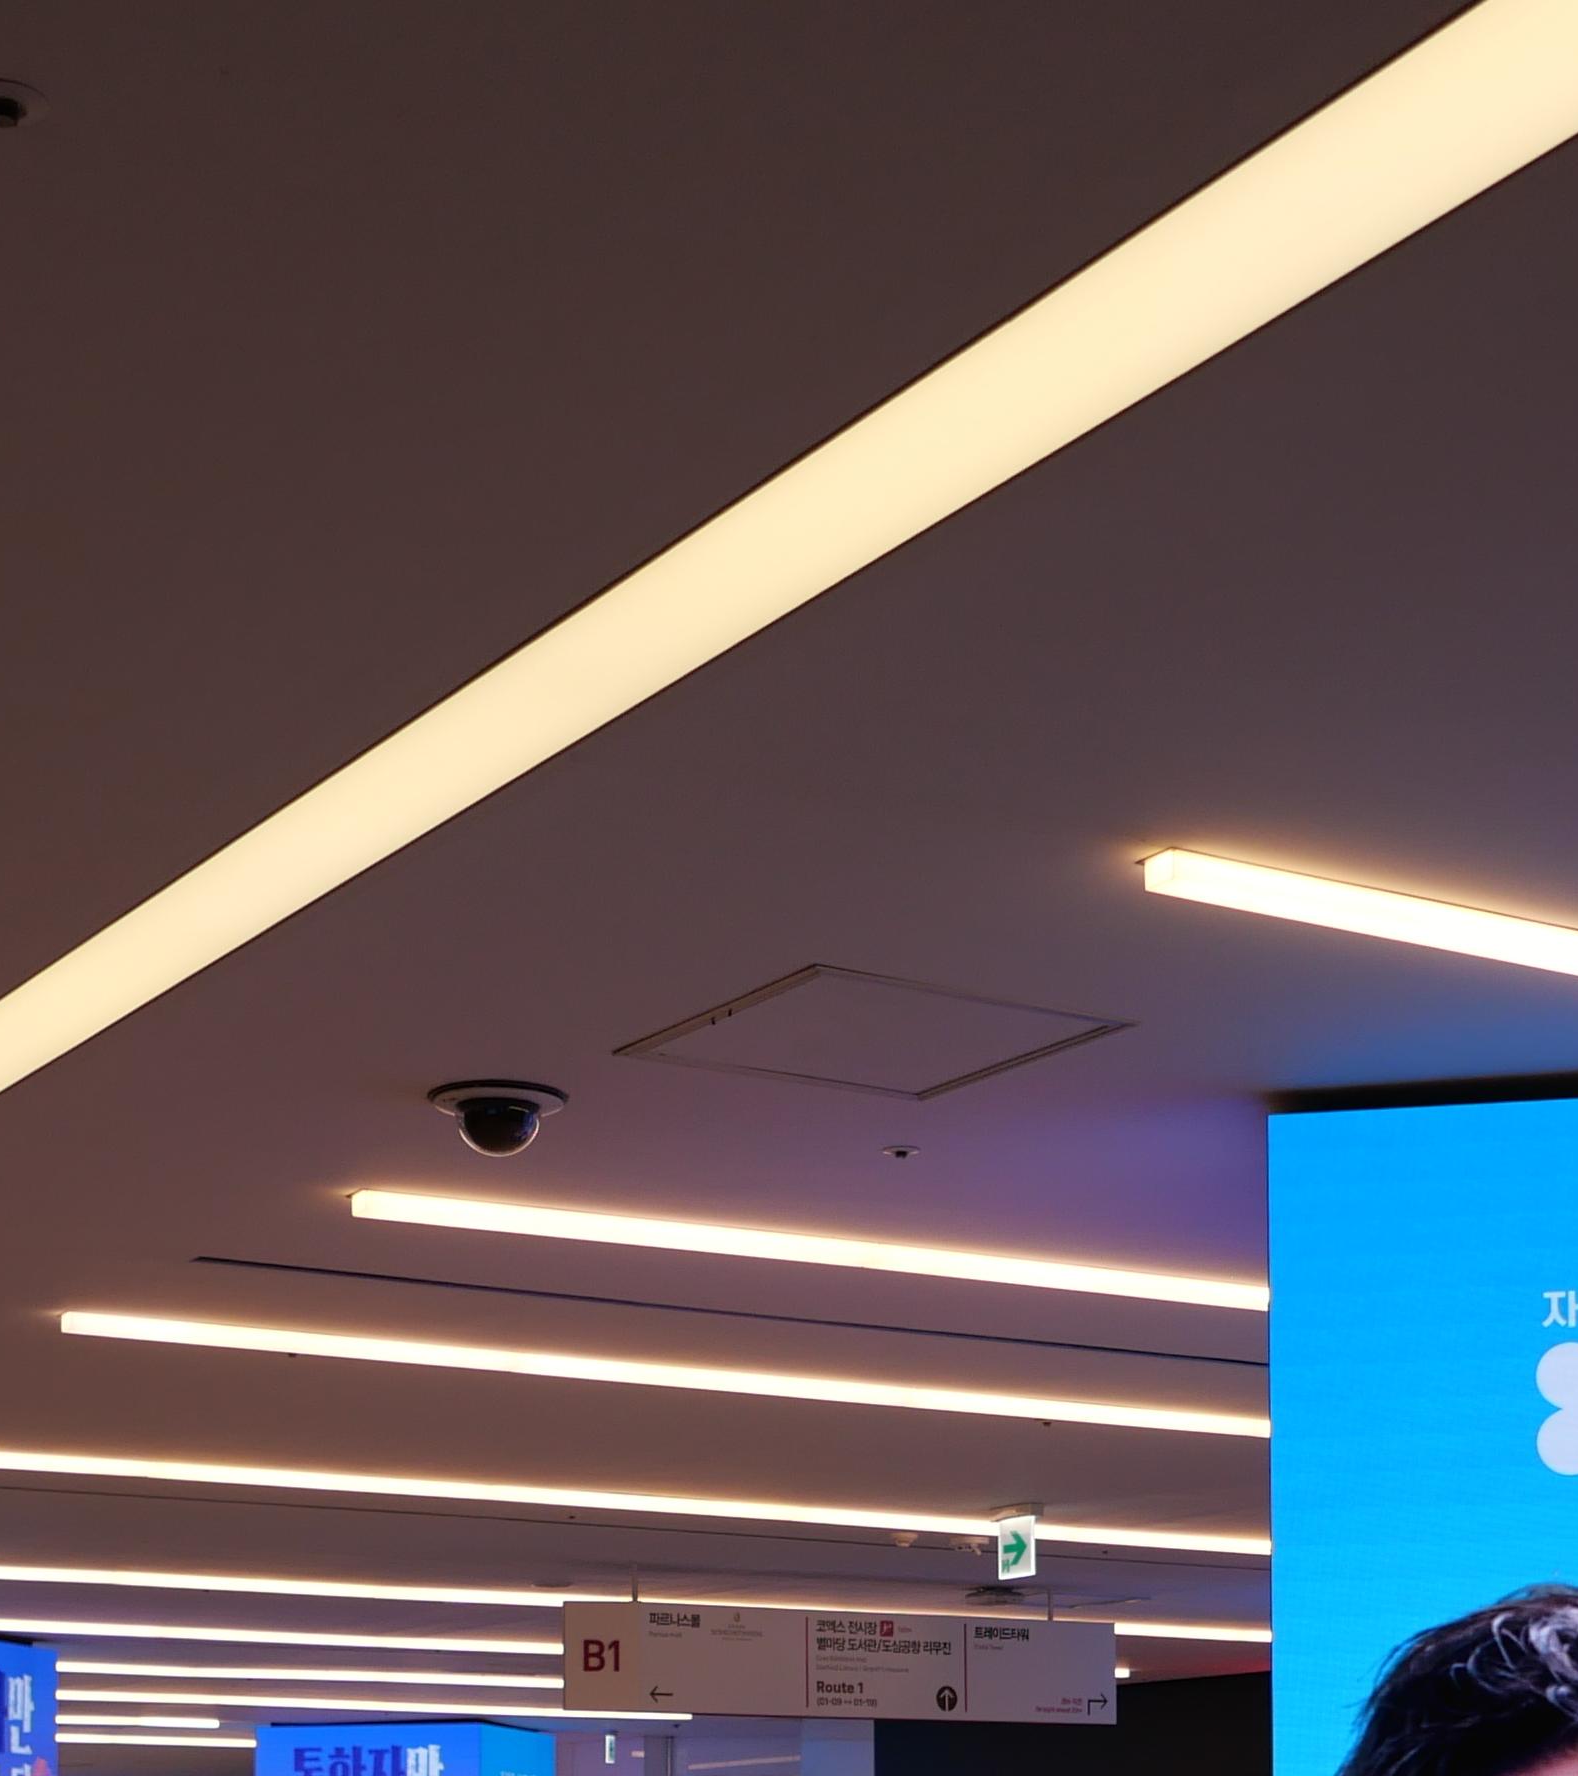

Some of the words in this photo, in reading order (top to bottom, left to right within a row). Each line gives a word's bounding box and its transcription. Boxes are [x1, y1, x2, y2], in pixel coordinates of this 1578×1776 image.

[649, 1612, 701, 1628] 파르나스몰
[816, 1619, 846, 1633] 코엑스
[847, 1621, 878, 1635] 전시장
[974, 1626, 1029, 1641] 트레이드타워
[583, 1639, 621, 1672] B1
[923, 1641, 952, 1656] 리무진
[816, 1681, 855, 1694] Route
[857, 1682, 864, 1694] 1
